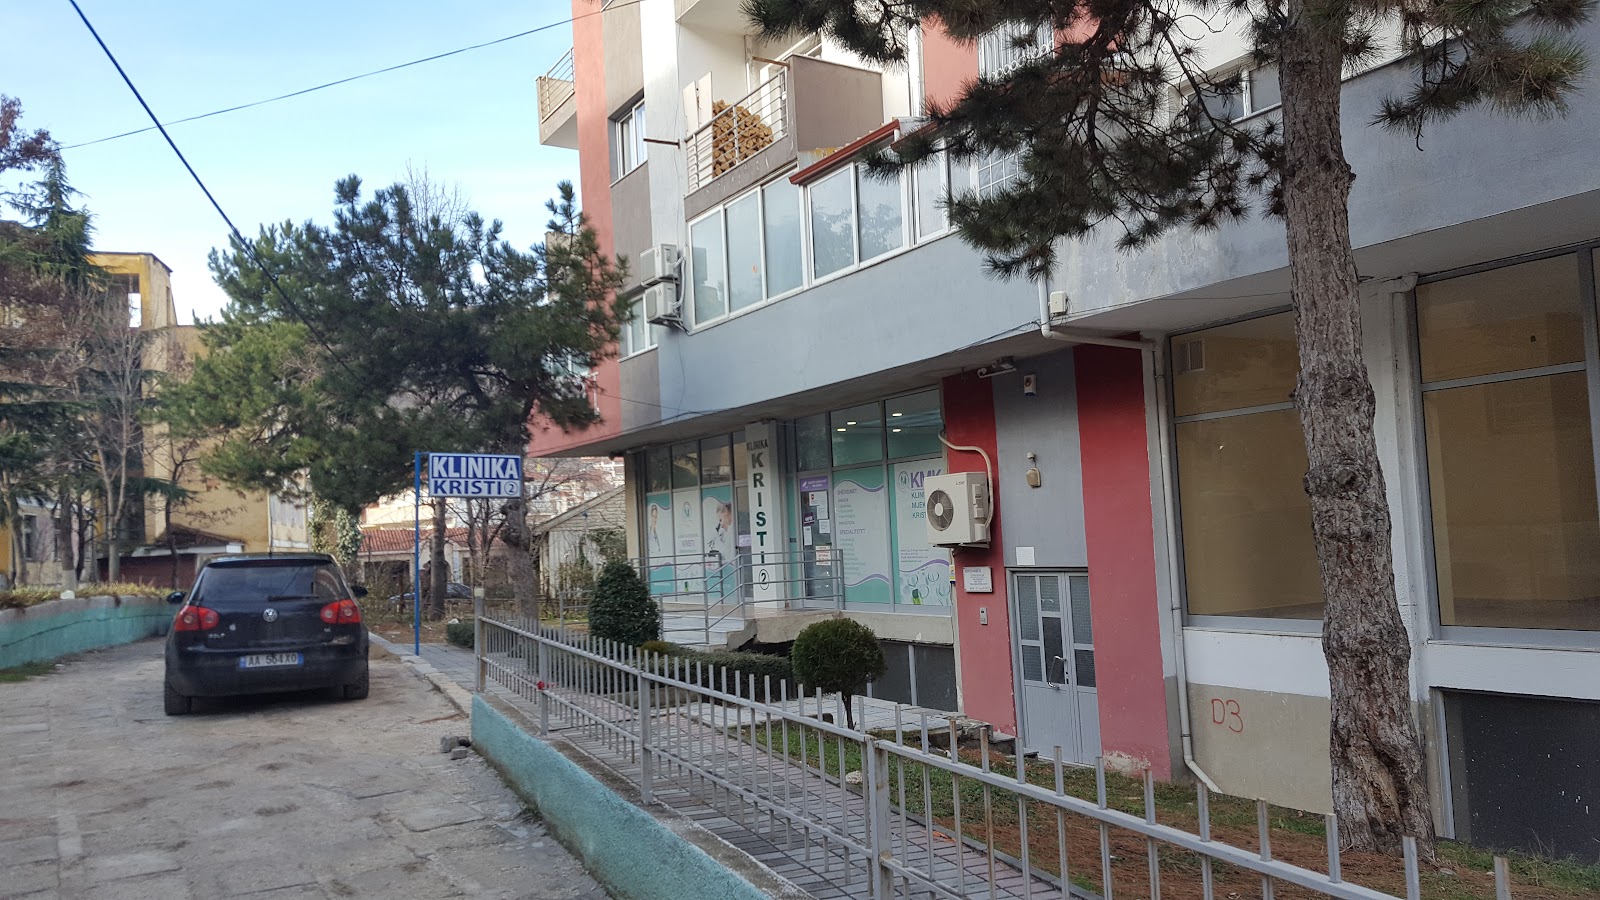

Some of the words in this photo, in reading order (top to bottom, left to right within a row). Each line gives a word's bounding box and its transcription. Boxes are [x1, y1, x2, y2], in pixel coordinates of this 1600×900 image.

[747, 439, 768, 450] KLINIKA
[432, 456, 518, 479] KLINIKA
[433, 480, 501, 495] KRISTI
[751, 453, 767, 564] KRISTI
[912, 511, 926, 519] KRIST
[1211, 698, 1244, 733] D3
